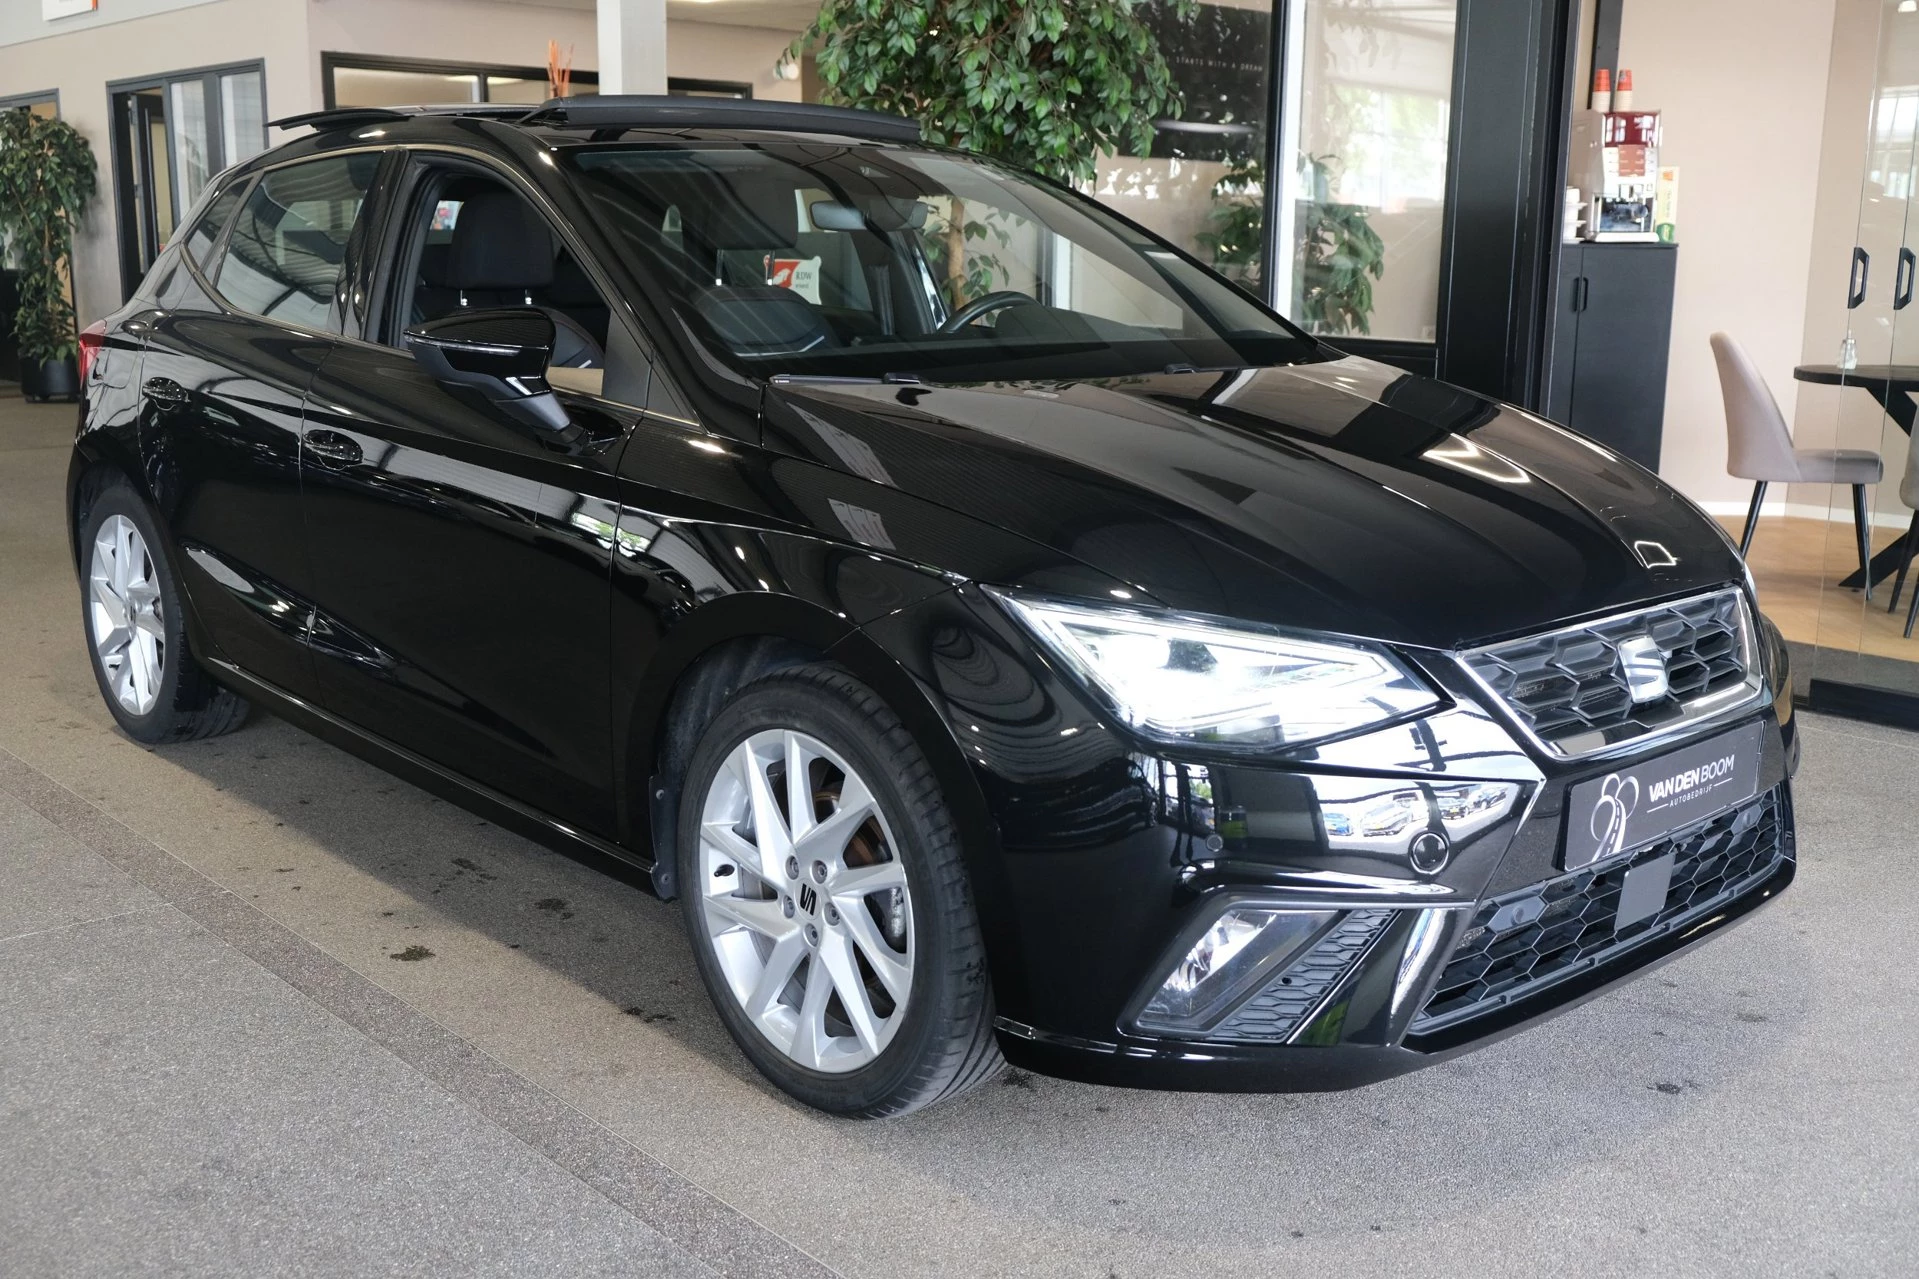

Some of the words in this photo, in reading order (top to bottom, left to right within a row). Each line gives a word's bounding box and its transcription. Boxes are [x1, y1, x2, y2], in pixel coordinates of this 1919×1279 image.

[1176, 56, 1204, 66] STARTS
[1208, 59, 1227, 68] WITH
[1240, 63, 1263, 73] DREAM
[795, 271, 812, 280] RDW
[1648, 776, 1675, 803] VAN
[1674, 767, 1701, 794] DEN
[1700, 754, 1735, 784] BOOM
[1669, 783, 1713, 808] AUTOBEDRIJF
